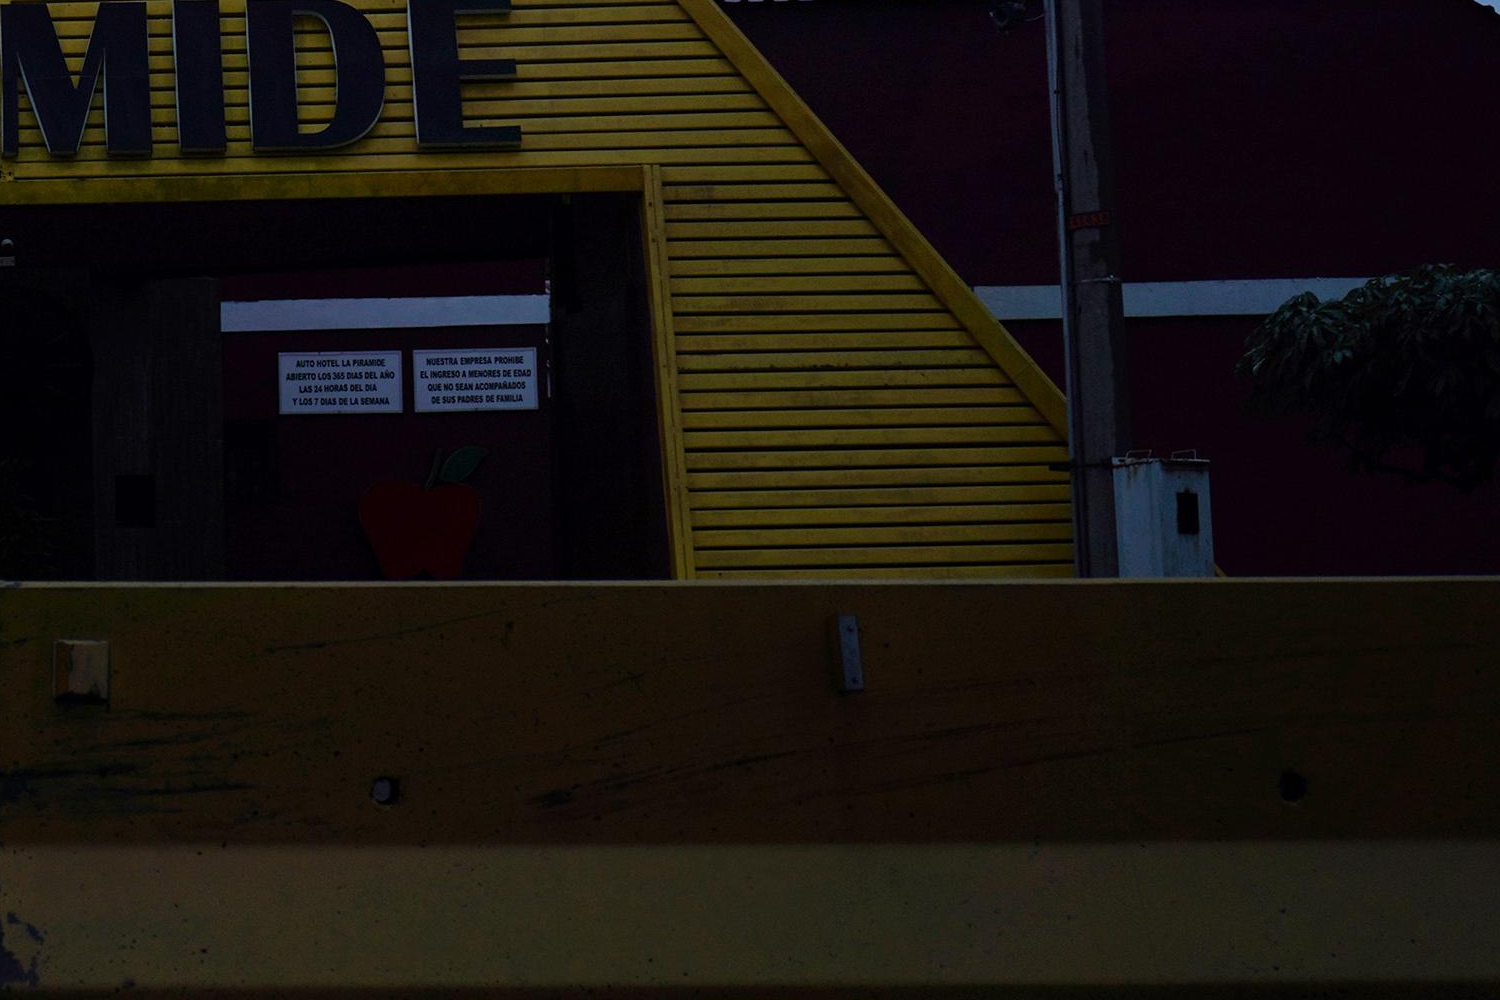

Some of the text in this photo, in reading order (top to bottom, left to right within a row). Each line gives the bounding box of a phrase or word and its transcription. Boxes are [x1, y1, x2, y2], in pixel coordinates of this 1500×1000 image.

[342, 359, 350, 367] LA
[495, 356, 524, 364] PROHIBE
[380, 369, 395, 379] AÑO
[475, 380, 525, 390] ACOMPAÑADOS
[361, 397, 389, 405] SEMANA
[432, 396, 441, 404] DE
